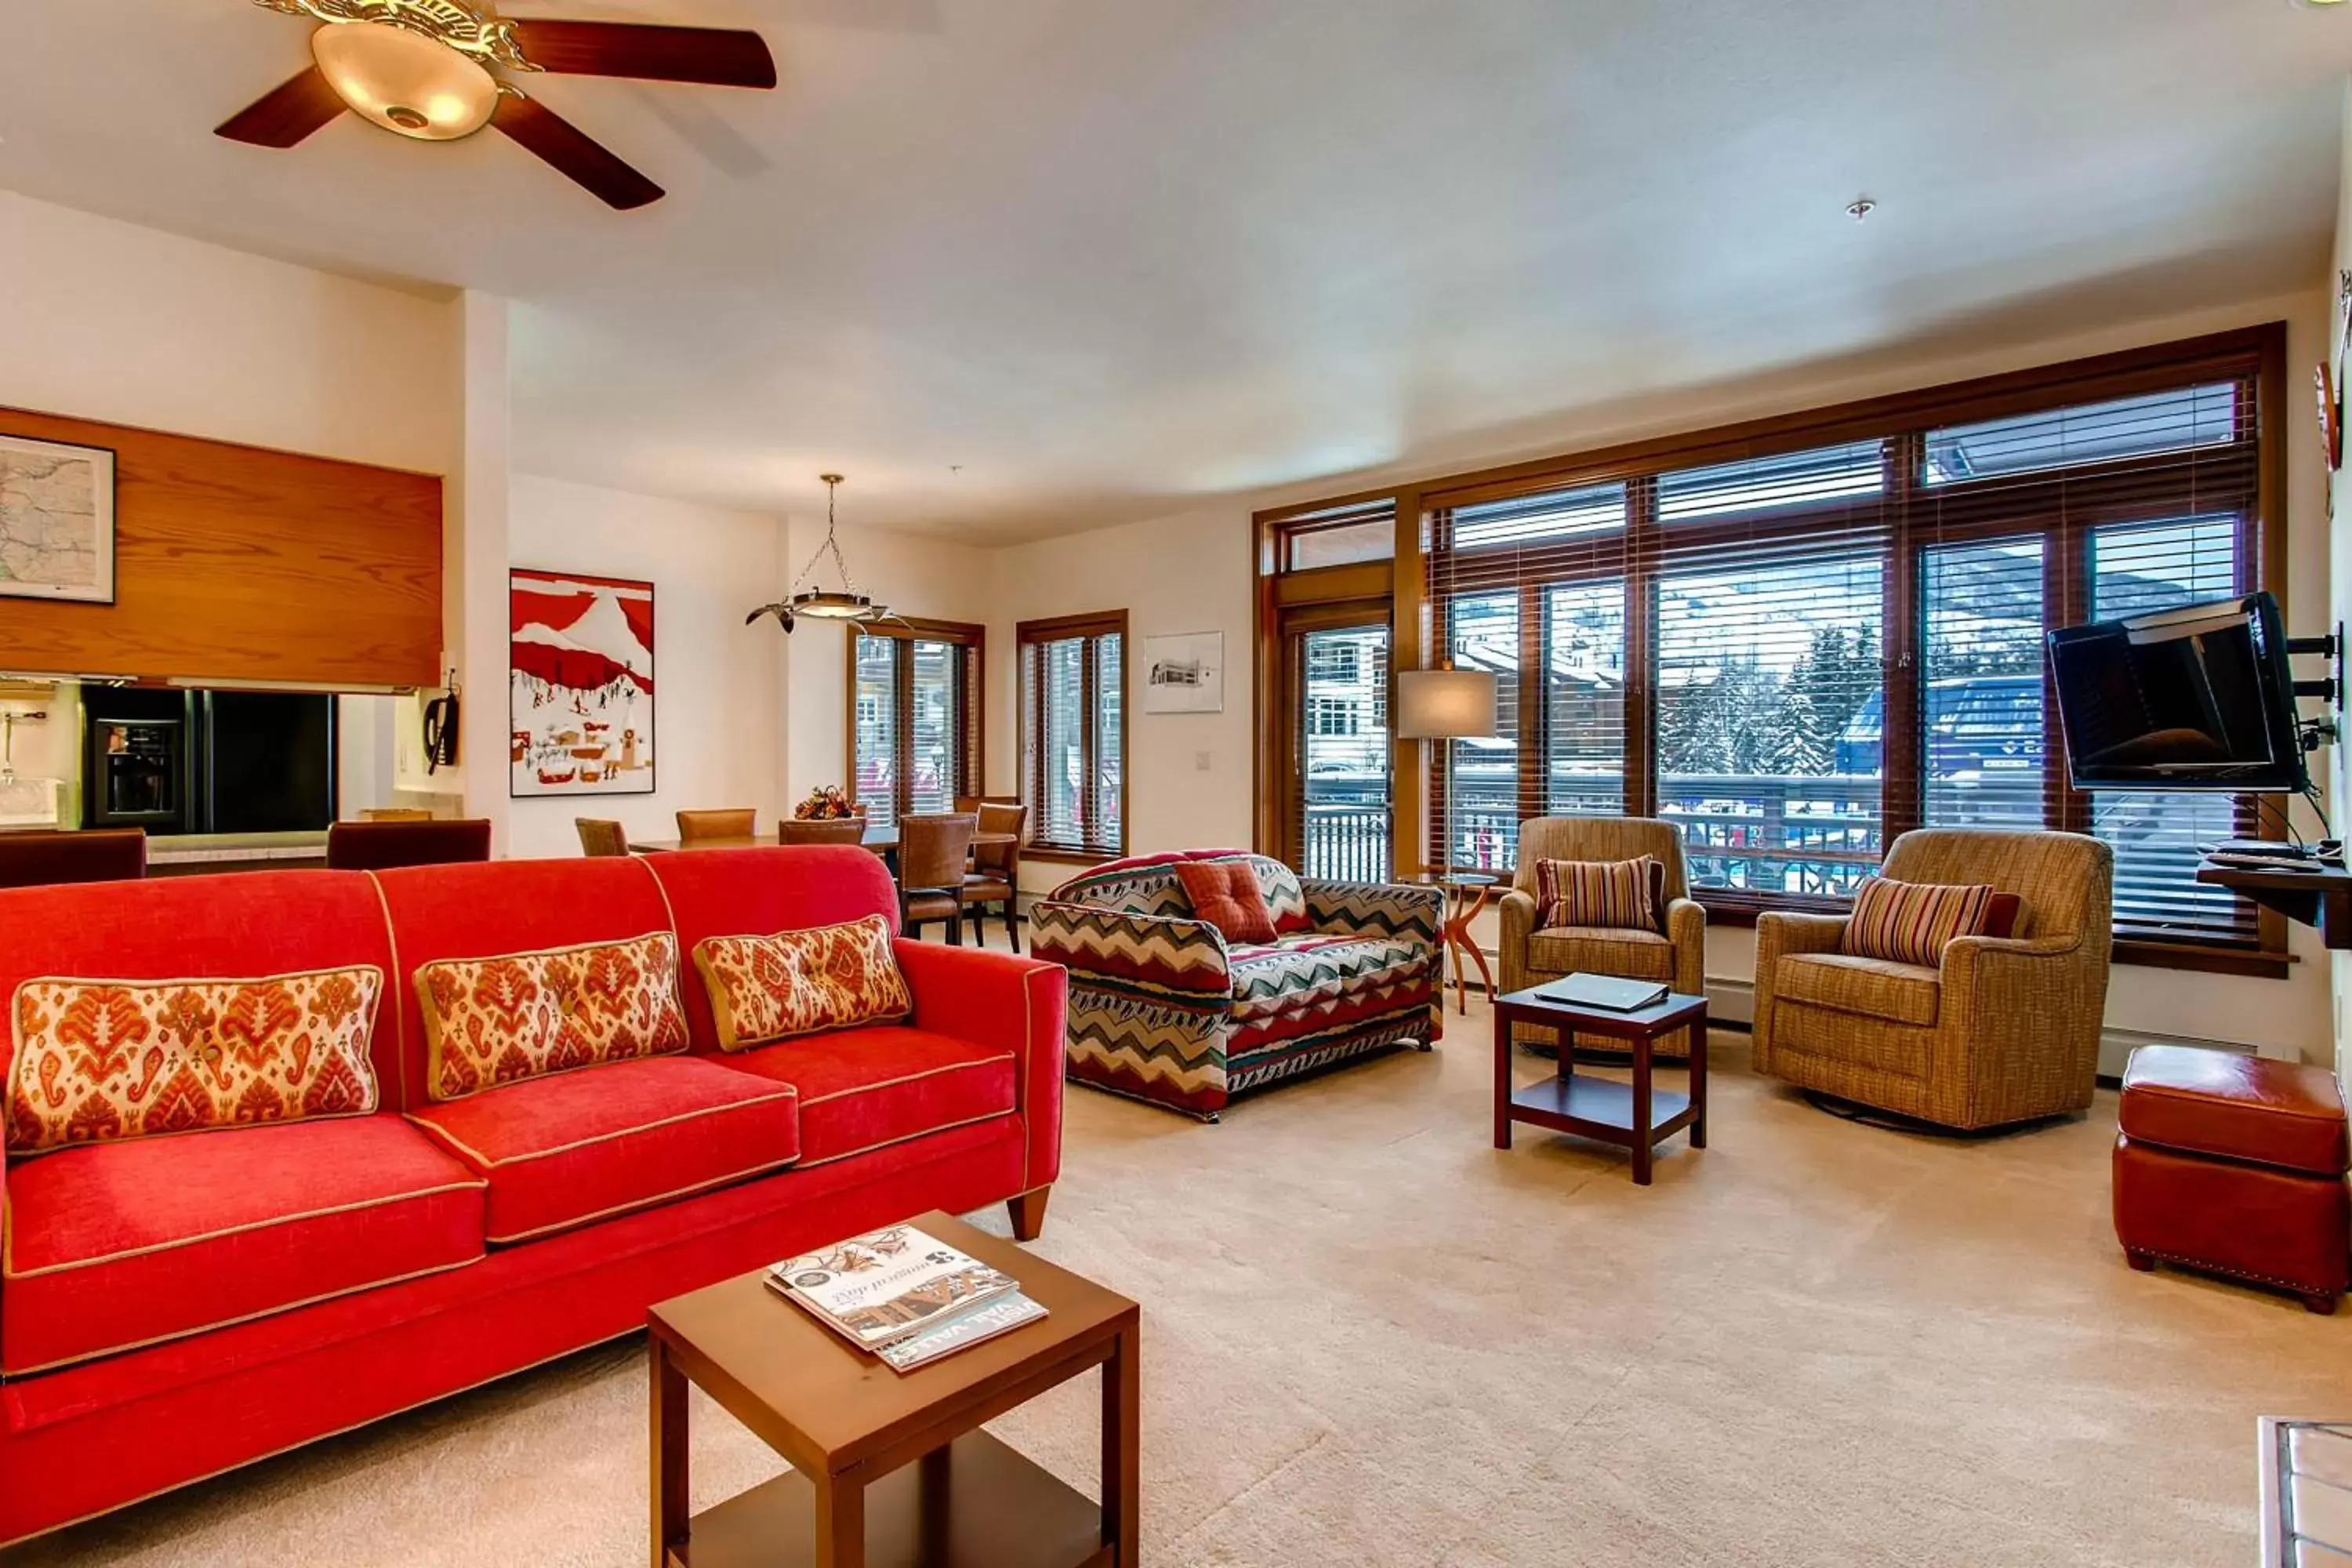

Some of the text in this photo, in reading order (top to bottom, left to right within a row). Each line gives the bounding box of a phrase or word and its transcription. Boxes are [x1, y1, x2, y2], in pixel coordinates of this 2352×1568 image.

[965, 1302, 1014, 1324] VAIL
[991, 1301, 1037, 1325] VISIT
[889, 1324, 970, 1363] VALLEY
